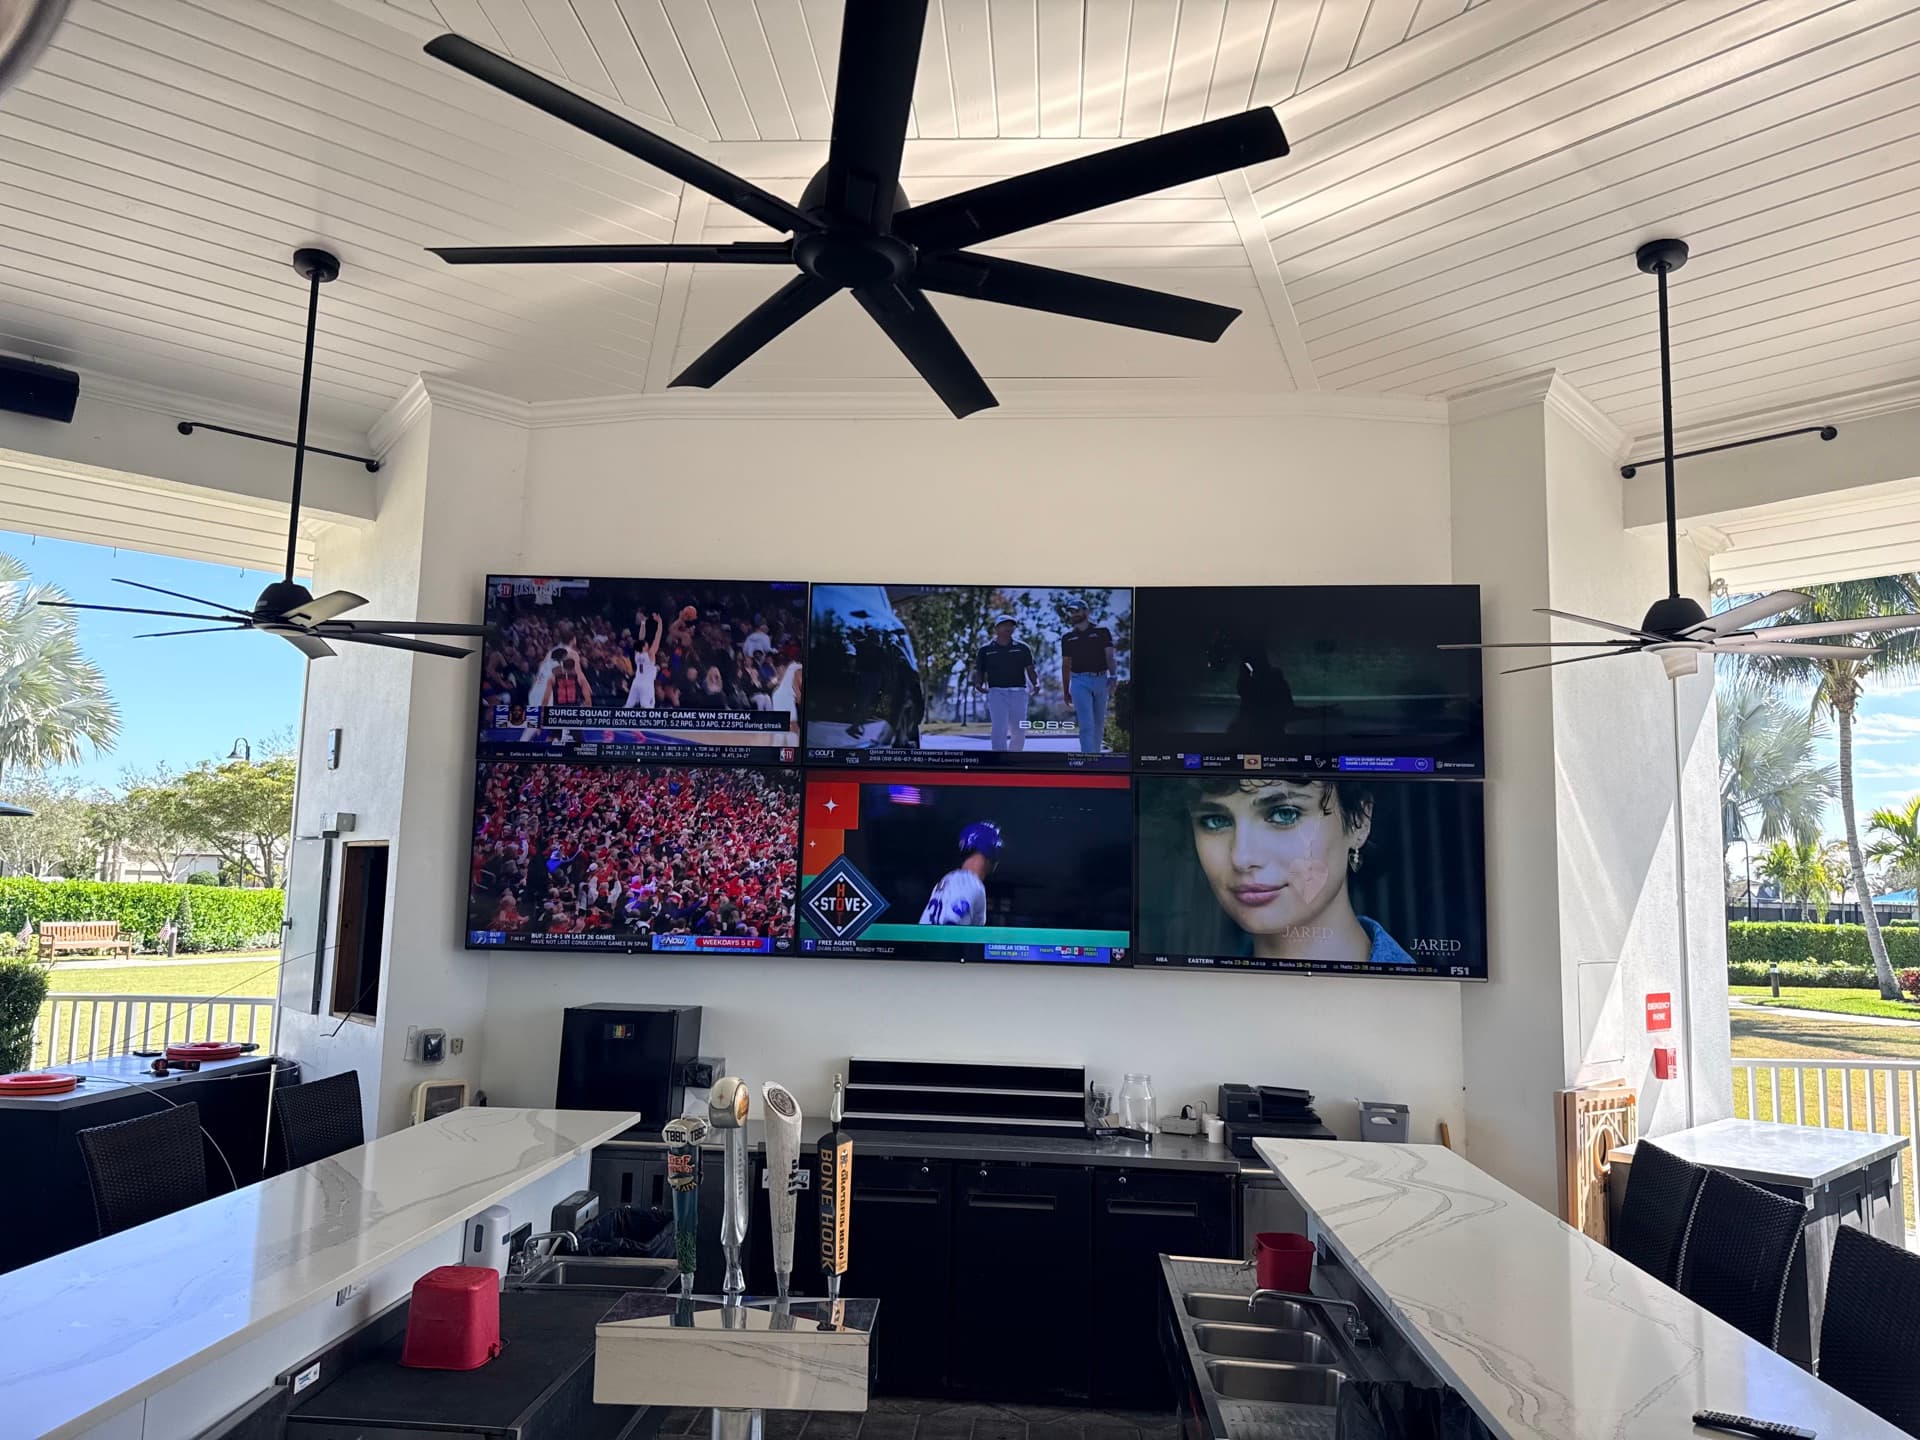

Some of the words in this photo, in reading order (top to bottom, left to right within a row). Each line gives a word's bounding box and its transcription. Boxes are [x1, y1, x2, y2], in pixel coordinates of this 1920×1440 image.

[548, 709, 578, 717] SURGE
[579, 709, 612, 717] SQUAD!
[615, 710, 647, 718] KNICKS
[648, 710, 661, 719] ON
[663, 711, 697, 719] 6-GAME
[699, 711, 716, 719] WIN
[717, 712, 751, 720] STREAK
[744, 721, 763, 730] during
[1019, 720, 1075, 730] BOB'S
[820, 897, 860, 912] STOVE
[804, 940, 813, 950] T
[1410, 938, 1462, 951] JARED
[1450, 966, 1470, 976] FS1
[665, 1130, 686, 1143] TBBC
[821, 1149, 833, 1208] BONE
[821, 1213, 834, 1273] HOOK
